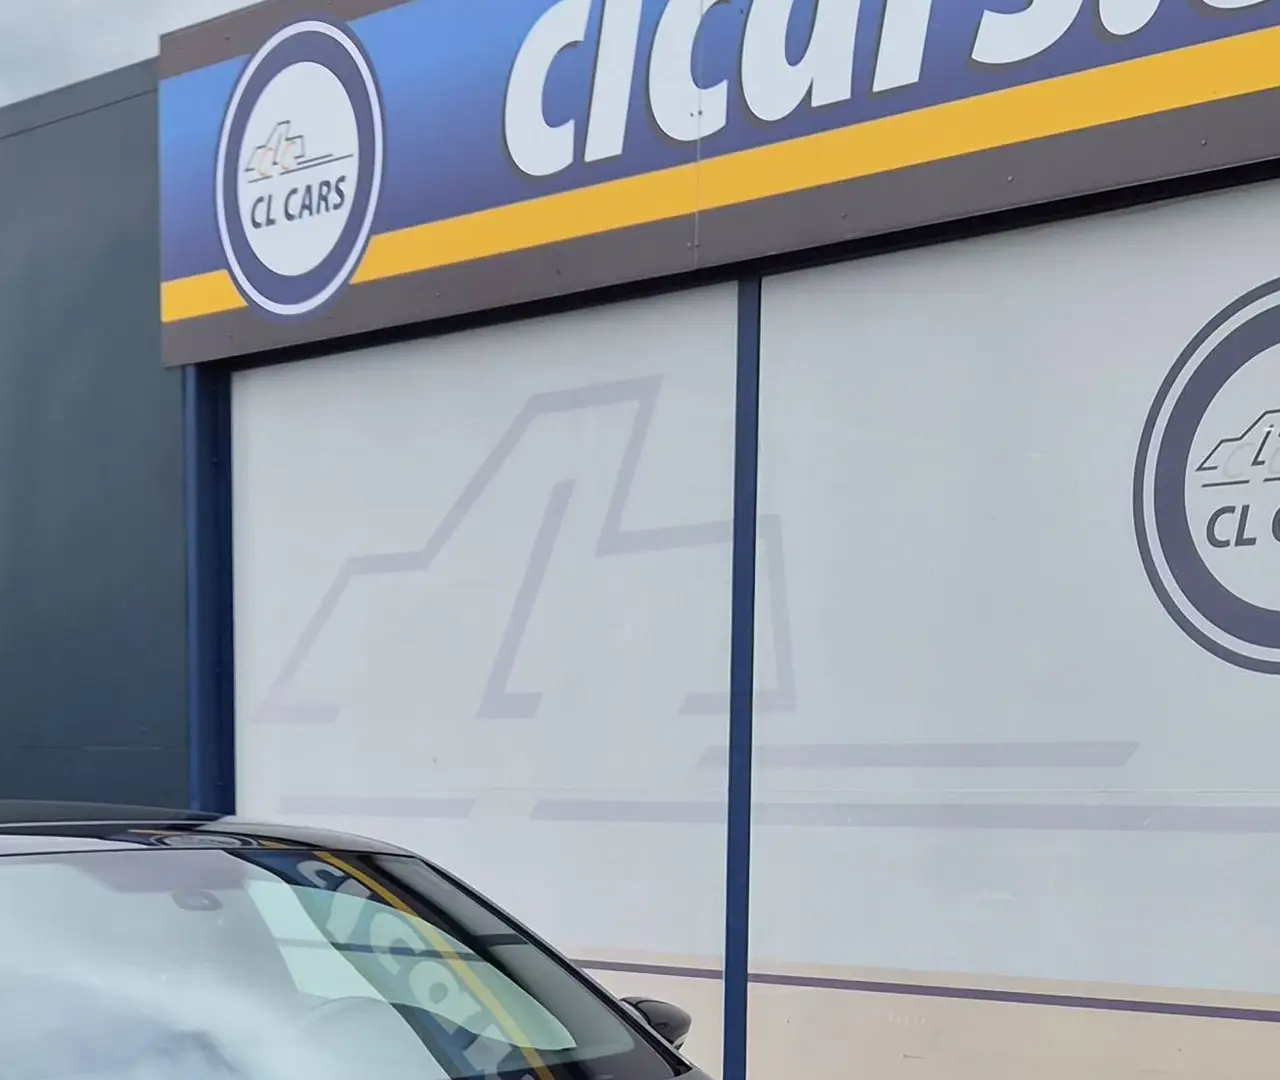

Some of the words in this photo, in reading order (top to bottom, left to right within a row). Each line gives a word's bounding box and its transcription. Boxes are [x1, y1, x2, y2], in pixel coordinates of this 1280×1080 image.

[504, 0, 1270, 176] clca.
[250, 193, 276, 229] CL
[284, 175, 346, 222] CARS
[1205, 504, 1258, 549] CL
